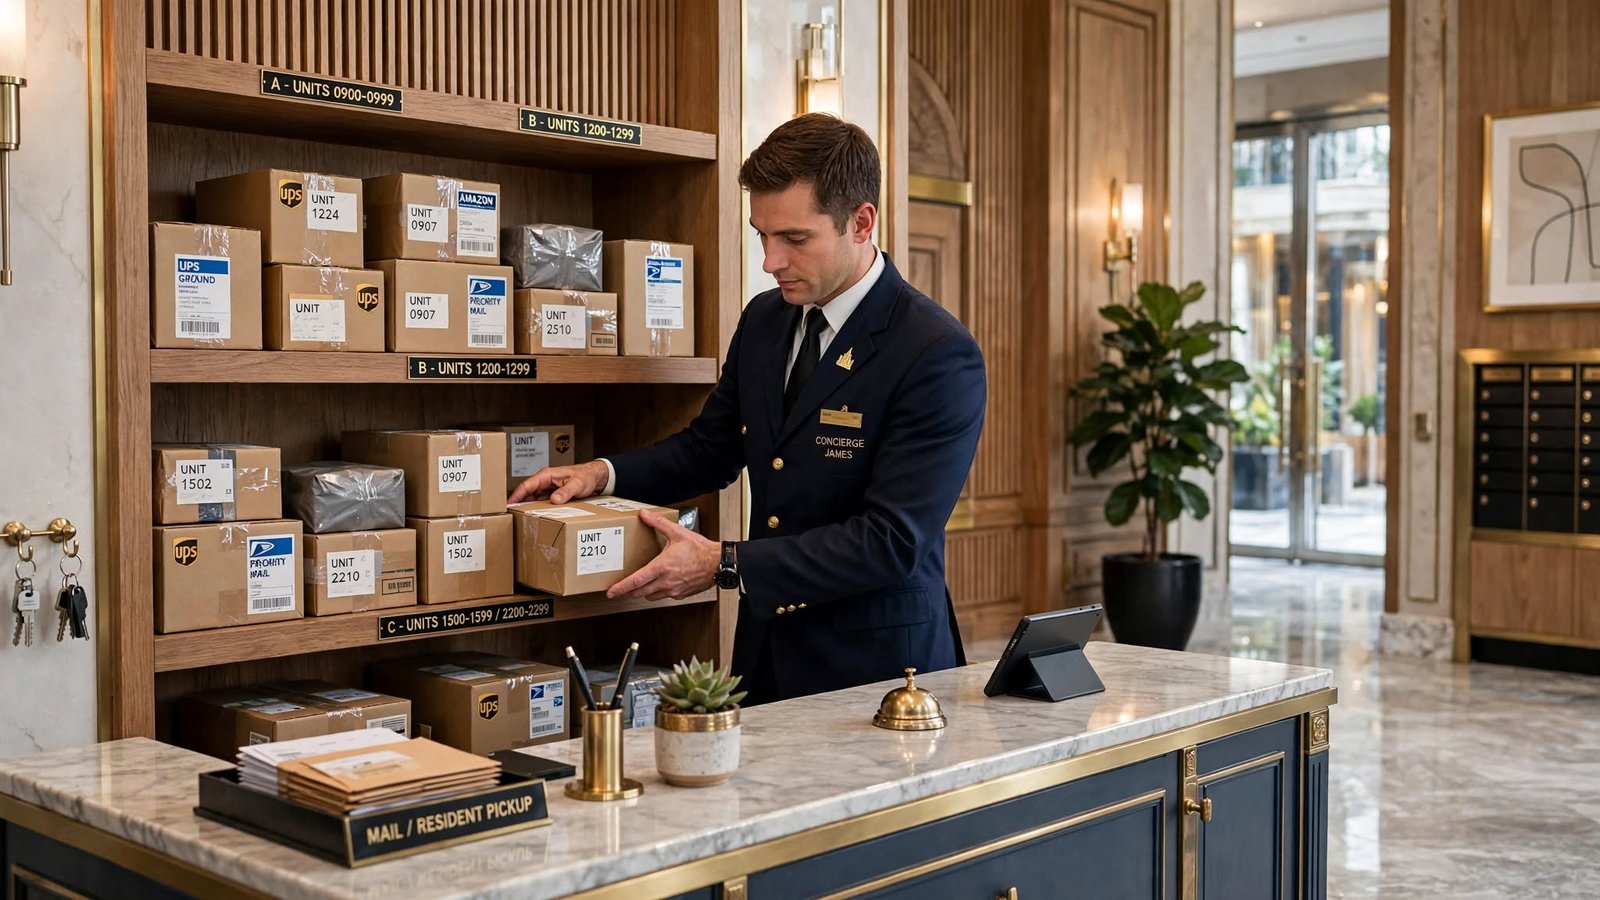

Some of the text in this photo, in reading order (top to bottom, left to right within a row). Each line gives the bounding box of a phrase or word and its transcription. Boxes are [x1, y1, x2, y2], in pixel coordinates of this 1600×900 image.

[271, 76, 281, 91] A
[293, 79, 330, 97] UNITS
[333, 86, 394, 106] 0900-0999
[528, 114, 537, 127] B
[547, 117, 580, 133] UNITS
[583, 122, 634, 141] 1200-1299
[280, 188, 302, 205] ups
[311, 194, 335, 205] UNIT
[459, 193, 494, 206] AMAZON
[312, 208, 339, 220] 1224
[411, 207, 433, 218] UNIT
[411, 220, 438, 232] 0907
[179, 260, 200, 272] UPS
[358, 292, 378, 309] ups
[409, 296, 432, 306] UNIT
[295, 303, 320, 313] UNIT
[409, 308, 436, 320] 0907
[546, 310, 567, 320] UNIT
[546, 324, 572, 335] 2510
[418, 361, 427, 374] B
[438, 362, 472, 375] UNITS
[476, 362, 530, 376] 1200-1299
[514, 436, 535, 446] UNIT
[815, 436, 865, 448] CONCIERGE
[824, 448, 853, 459] JAMES
[180, 464, 207, 475] UNIT
[442, 458, 463, 469] UNIT
[442, 472, 468, 483] 0907
[181, 478, 212, 490] 1502
[447, 534, 469, 546] UNIT
[580, 532, 602, 544] UNIT
[175, 546, 198, 564] ups
[448, 548, 473, 560] 1502
[580, 545, 607, 558] 2210
[331, 557, 355, 568] UNIT
[331, 570, 360, 584] 2210
[388, 620, 396, 634] C
[406, 615, 439, 632] UNITS
[442, 609, 493, 627] 1500-1599
[502, 603, 550, 620] 2200-2299
[480, 700, 498, 718] ups
[366, 795, 533, 845] MAIL / RESIDENT PICKUP
